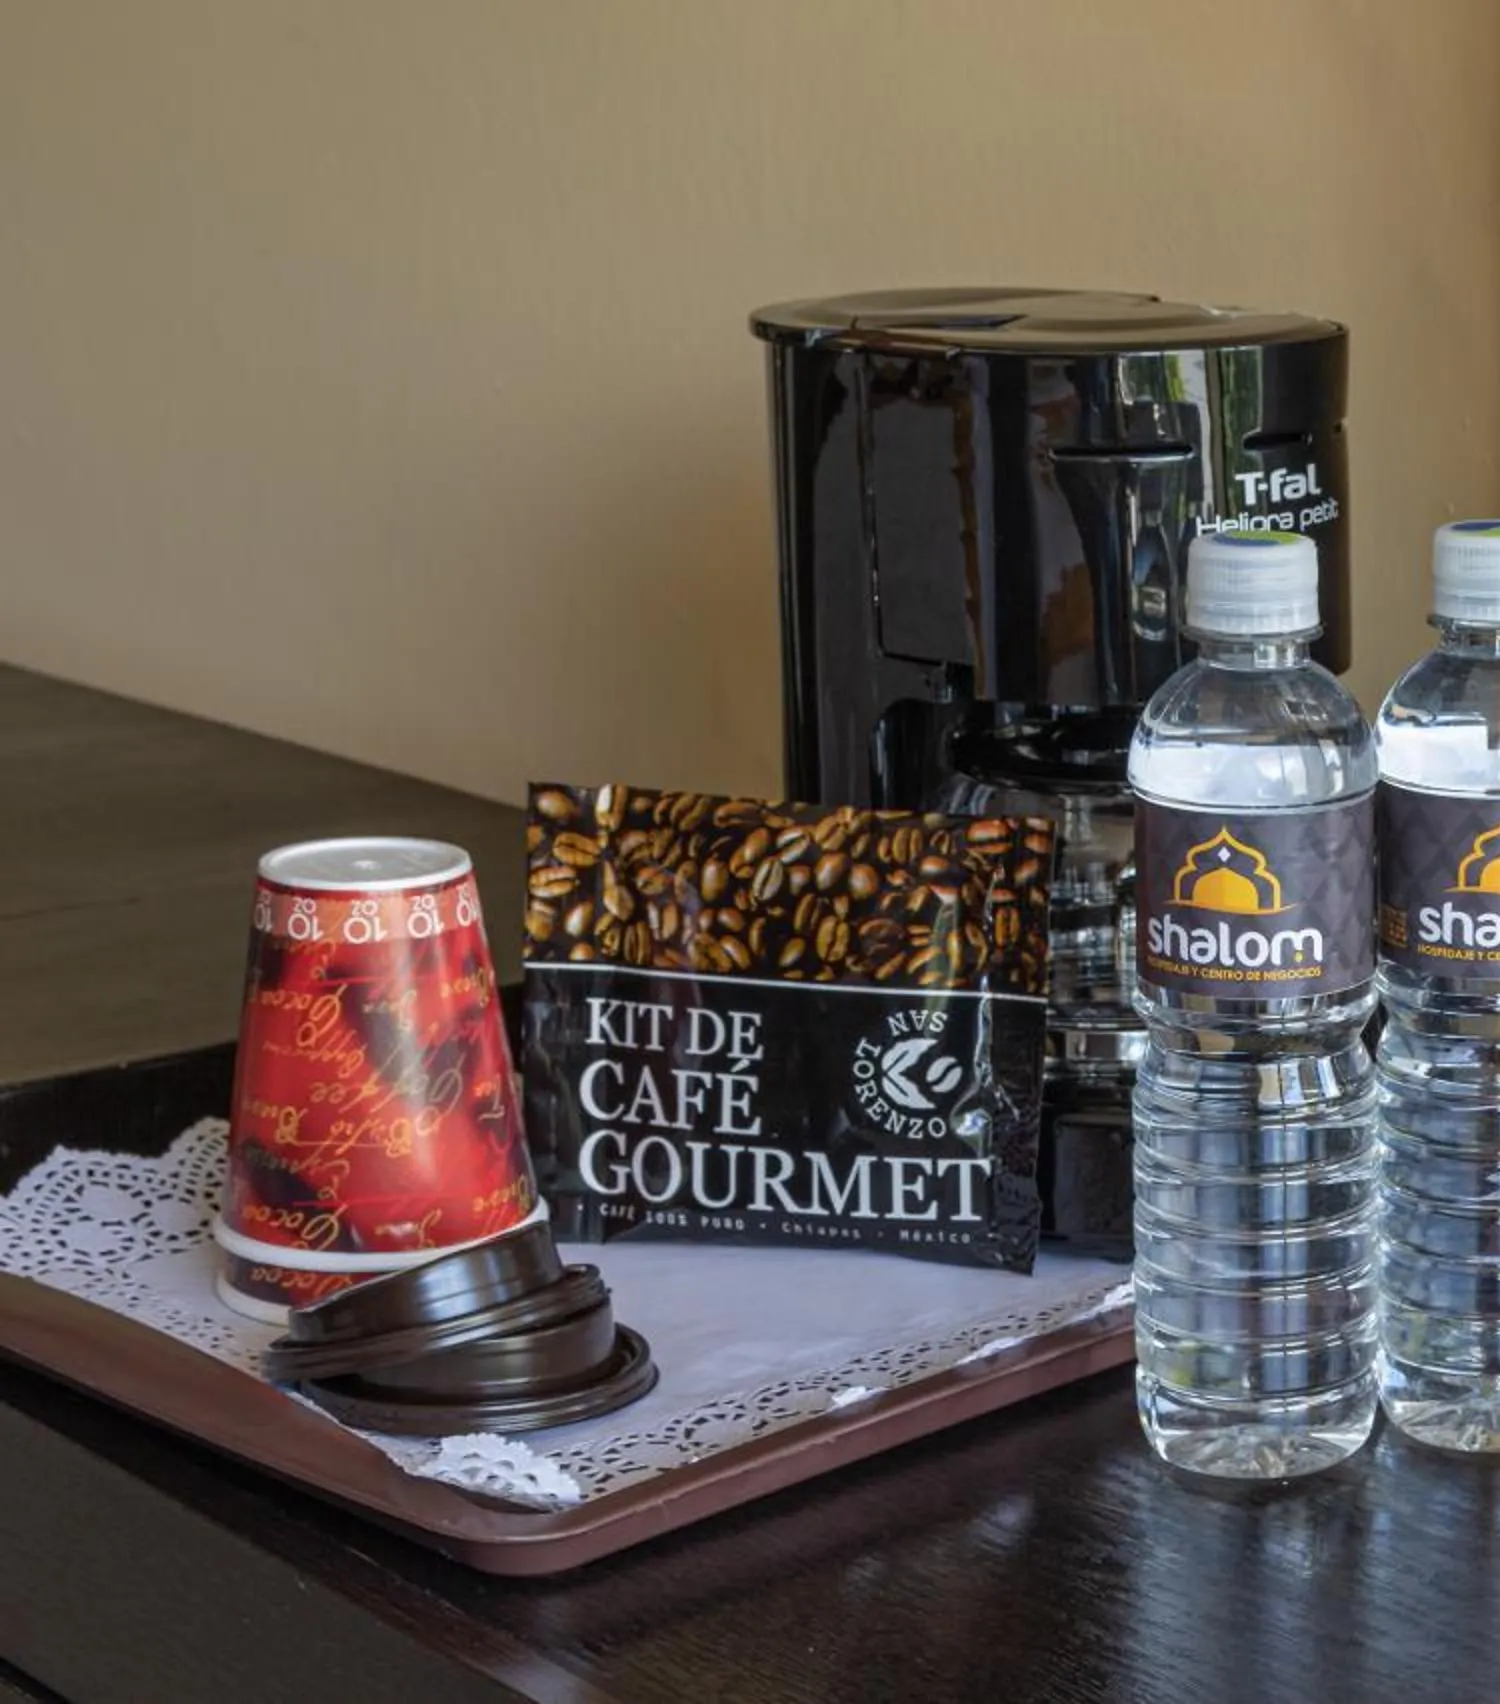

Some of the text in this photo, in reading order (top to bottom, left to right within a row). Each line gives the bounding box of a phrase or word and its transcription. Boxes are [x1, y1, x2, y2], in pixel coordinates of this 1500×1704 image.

[1234, 463, 1322, 506] T-fal
[1300, 498, 1339, 533] petit
[287, 912, 323, 941] 10
[343, 916, 387, 944] 10
[406, 911, 444, 938] 10
[1147, 914, 1323, 967] shalom
[1191, 966, 1200, 977] Y
[1201, 967, 1244, 980] CENTRO
[1246, 970, 1261, 981] DE
[1263, 966, 1322, 981] NEGOCIOS
[584, 997, 765, 1061] KIT DE
[854, 1009, 949, 1140] SAN LORENZO
[579, 1059, 762, 1137] CAFÉ
[578, 1129, 992, 1222] GOURMET
[600, 1203, 972, 1245] CAFÉ 100% PURO Chiapas México
